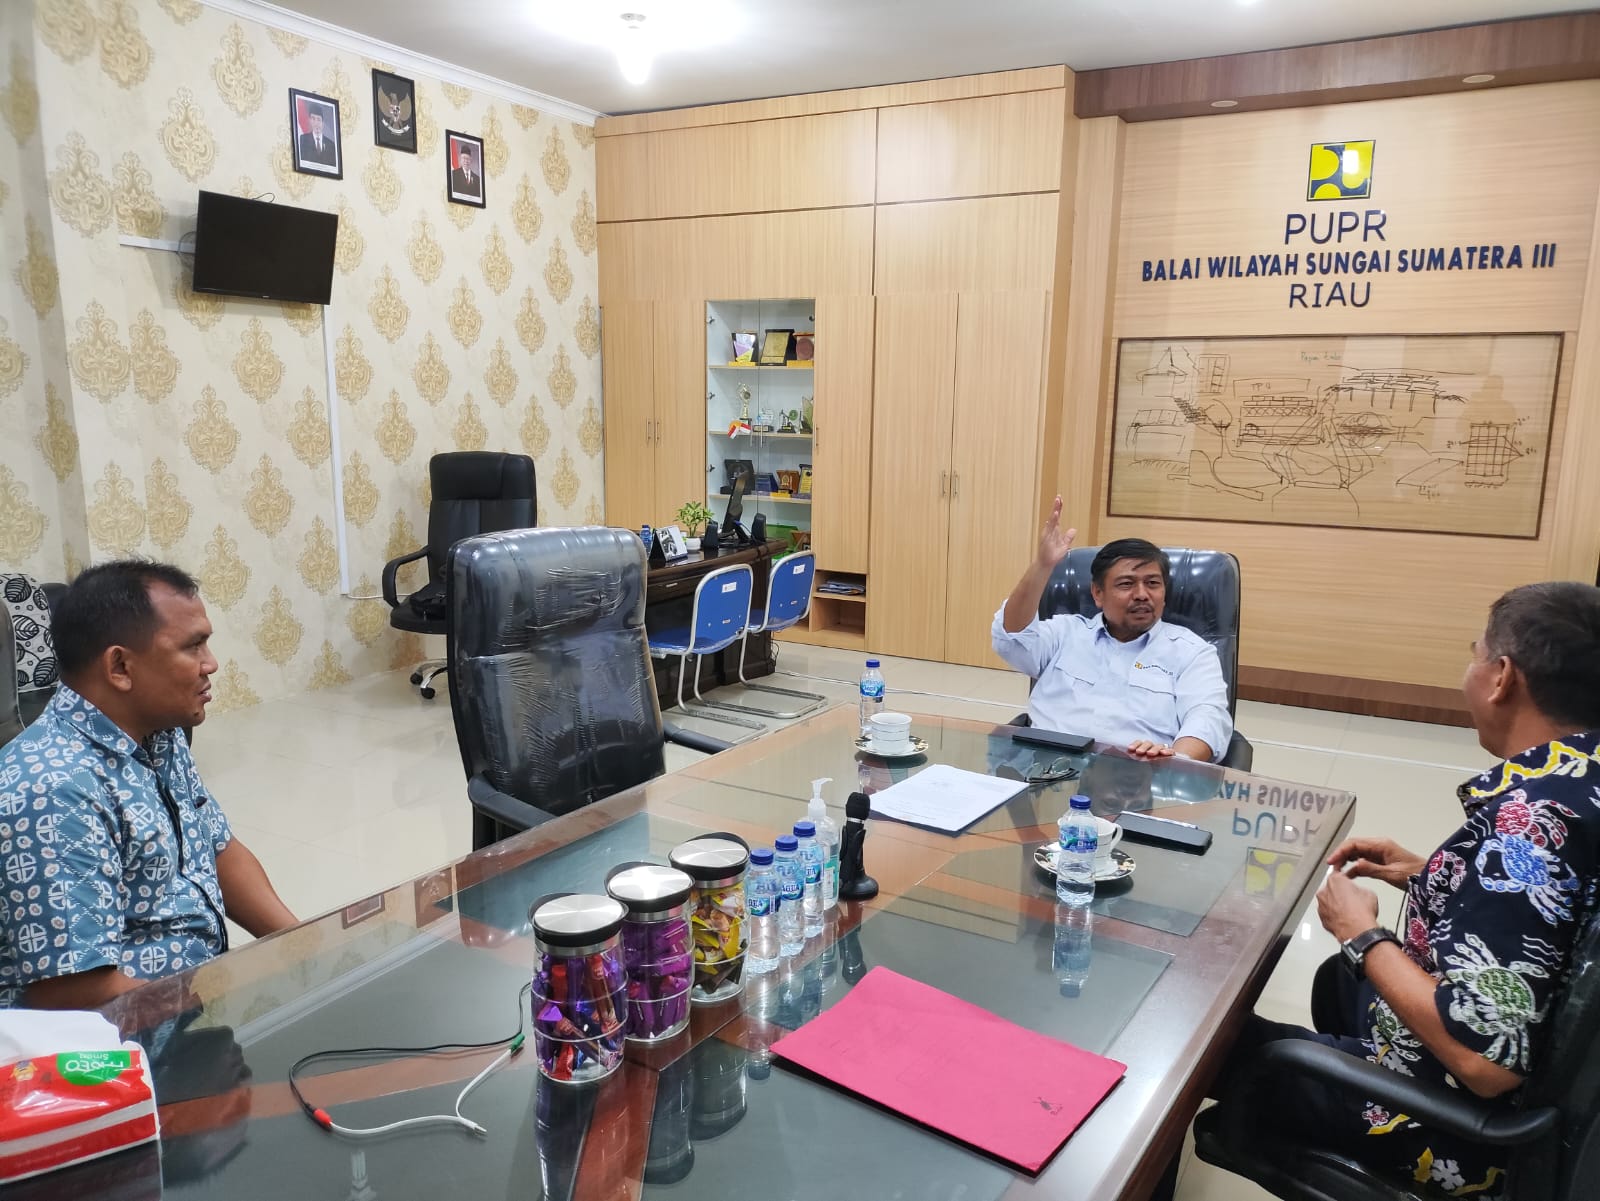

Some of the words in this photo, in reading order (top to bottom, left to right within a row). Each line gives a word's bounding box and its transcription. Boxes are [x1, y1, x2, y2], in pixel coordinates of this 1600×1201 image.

[1284, 209, 1387, 245] PUPR
[1142, 257, 1201, 282] BALAI
[1207, 253, 1299, 279] WILAYAH
[1306, 250, 1391, 276] SUNGAI
[1397, 244, 1523, 273] SUMATERA
[1532, 243, 1557, 268] III
[1289, 281, 1371, 308] RIAU
